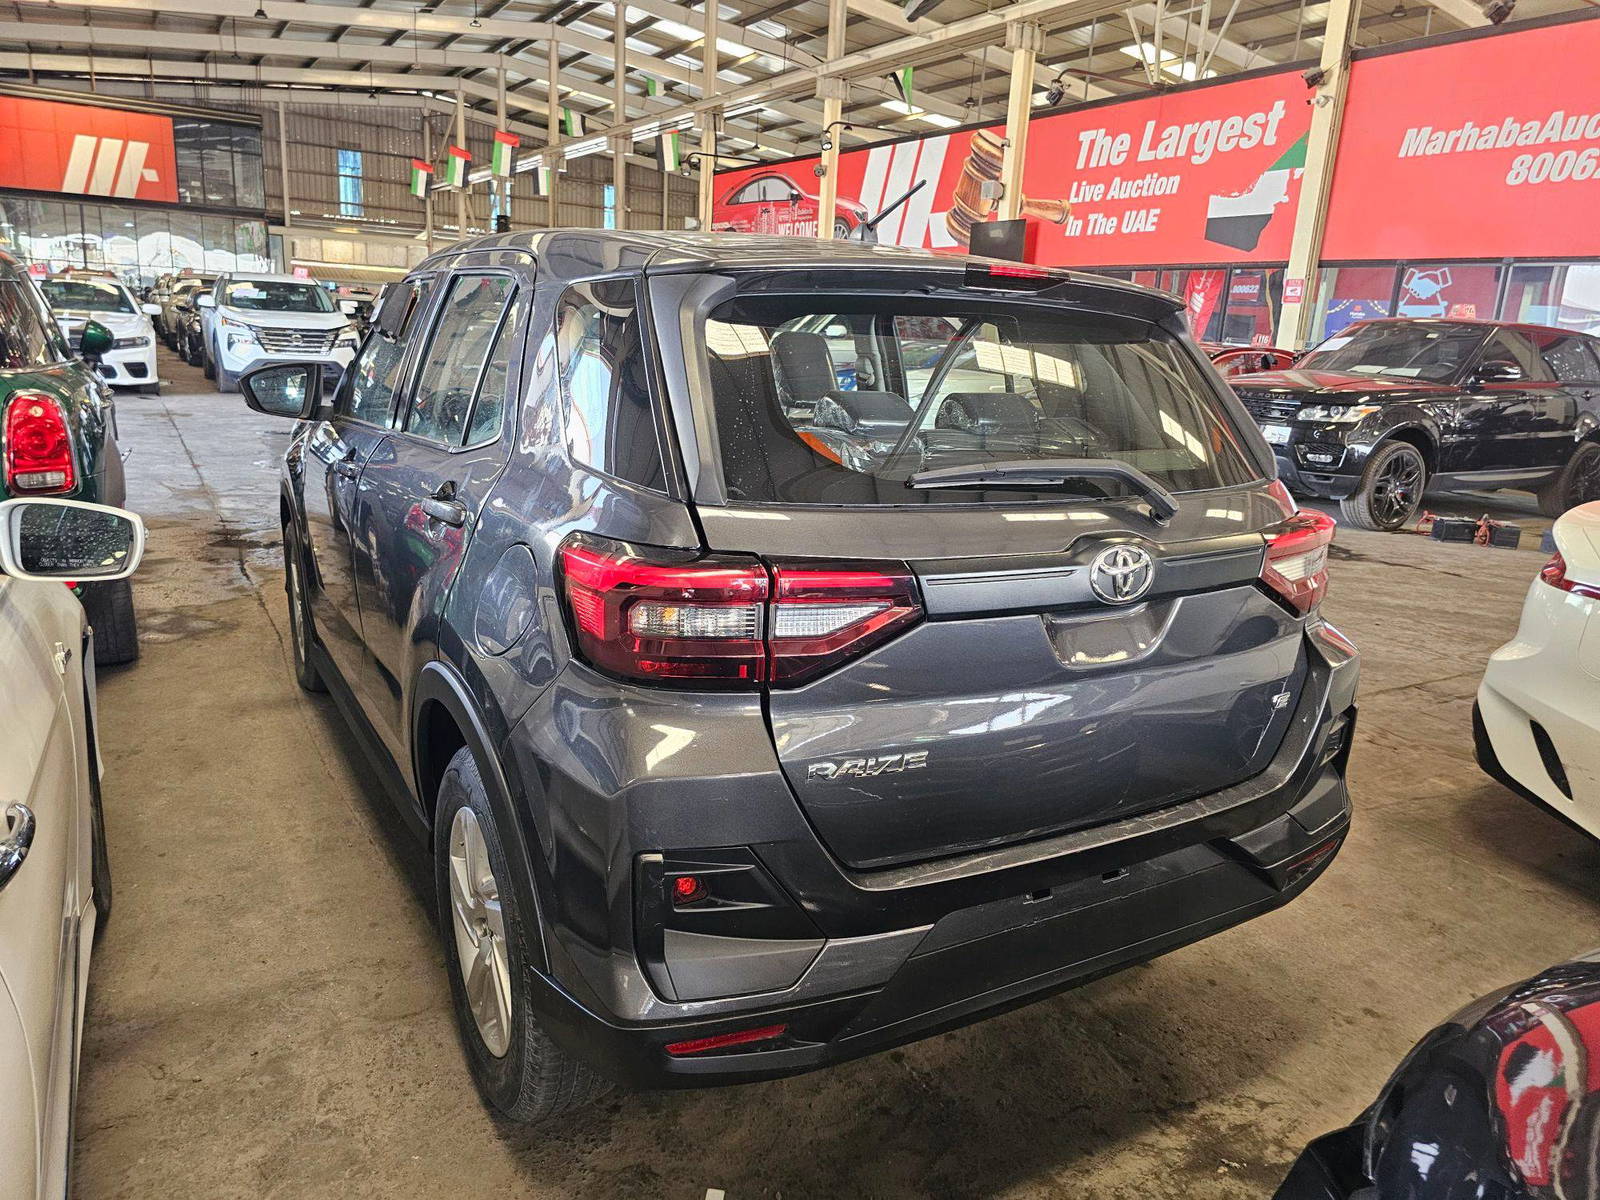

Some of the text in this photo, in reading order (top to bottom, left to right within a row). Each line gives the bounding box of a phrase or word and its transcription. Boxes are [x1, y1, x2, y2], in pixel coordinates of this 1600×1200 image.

[1075, 99, 1286, 170] The Largest
[1398, 110, 1600, 158] MarhabaAuc
[1069, 173, 1180, 204] Live Auction
[778, 221, 818, 237] WELCOME
[1064, 208, 1161, 237] In The UAE
[805, 751, 929, 783] RAIZE
